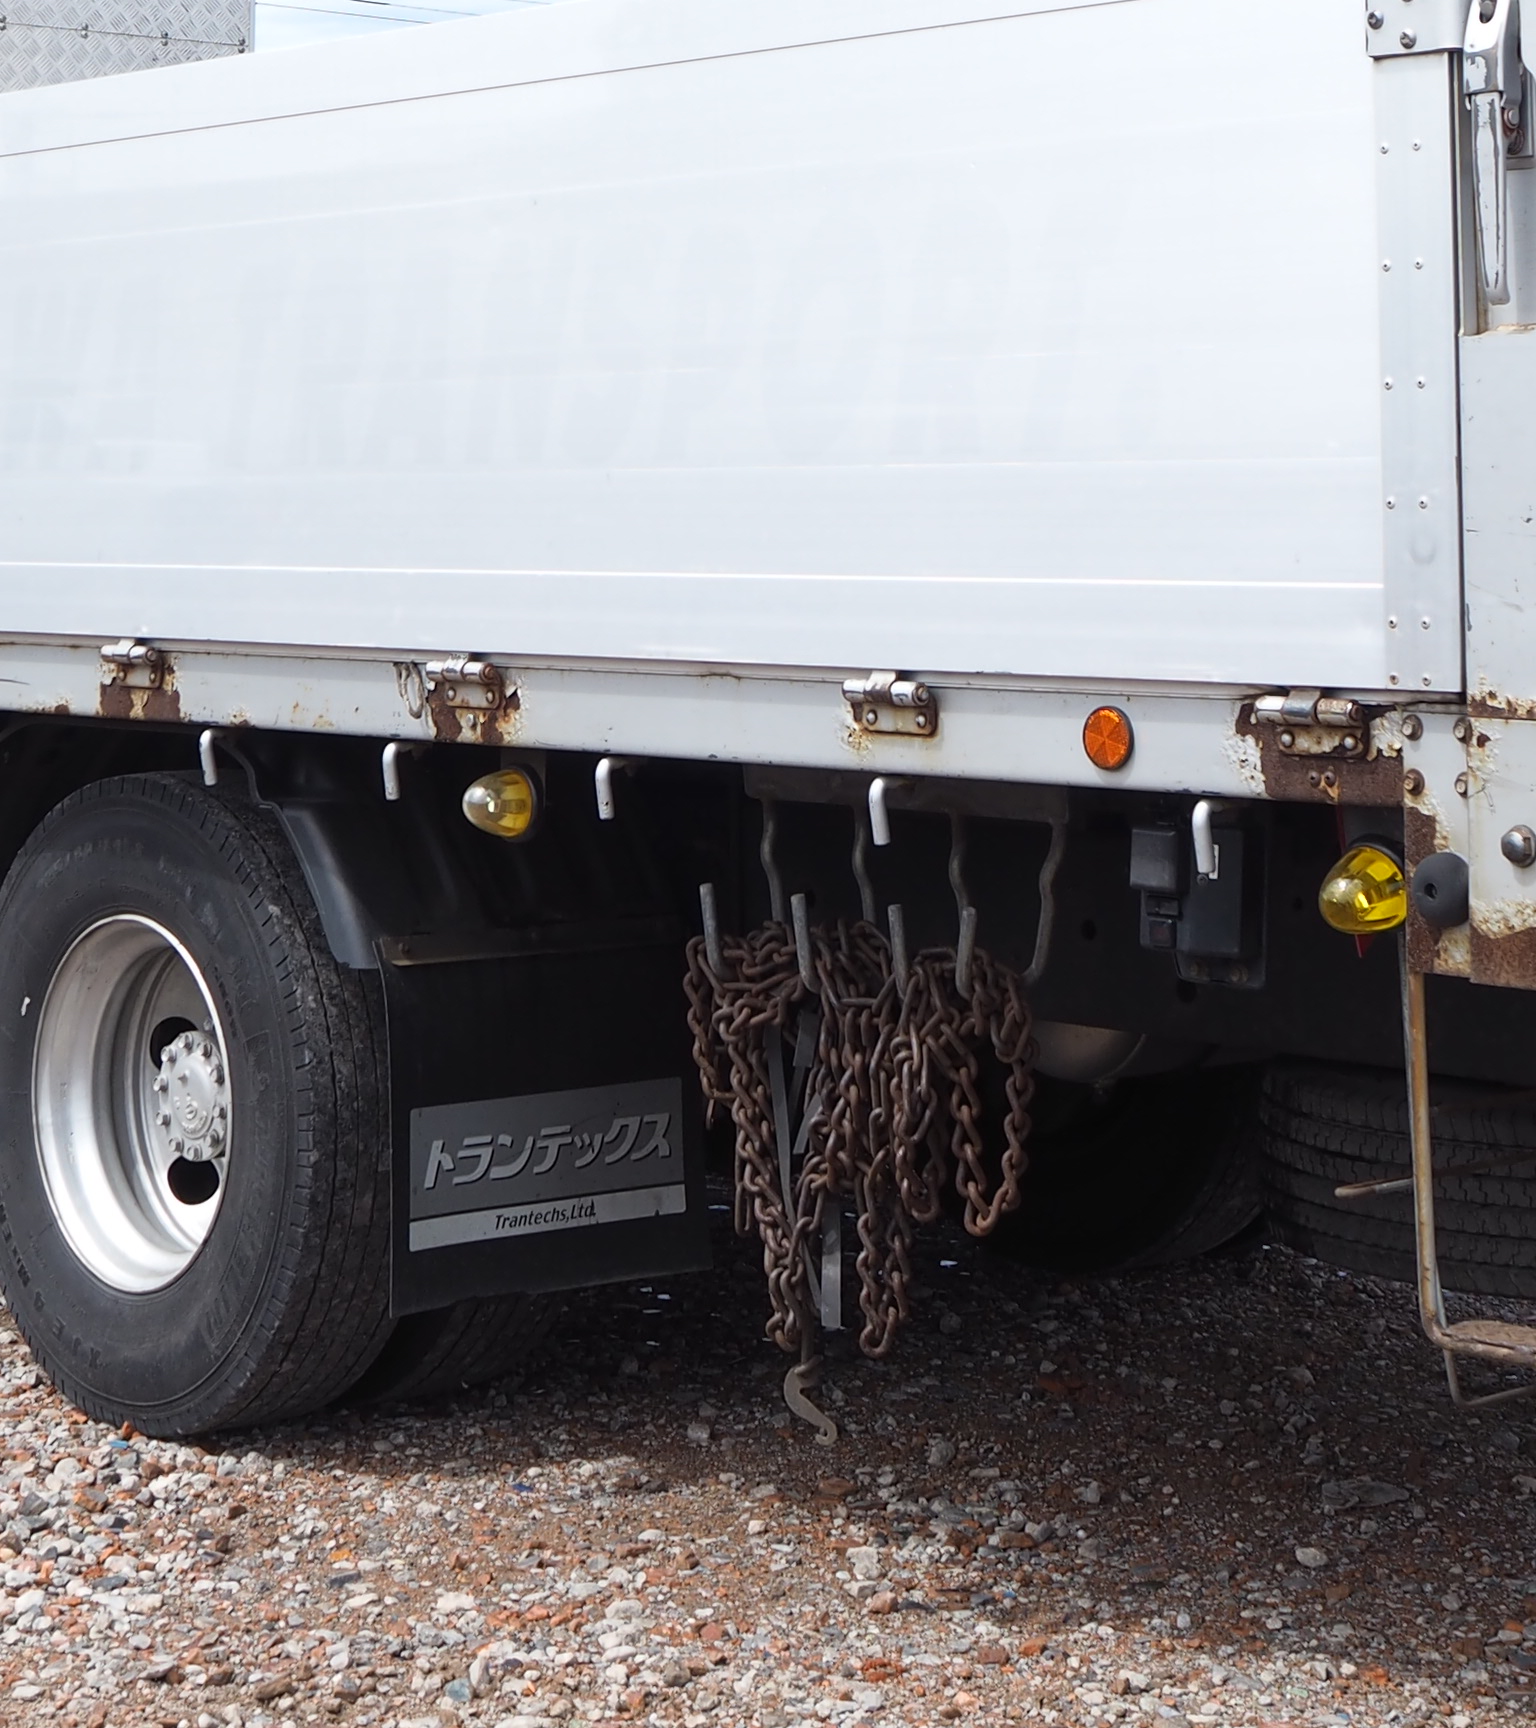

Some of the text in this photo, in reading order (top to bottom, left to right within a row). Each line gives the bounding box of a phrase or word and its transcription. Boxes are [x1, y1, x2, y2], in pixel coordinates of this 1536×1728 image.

[423, 1112, 672, 1190] トランテックス
